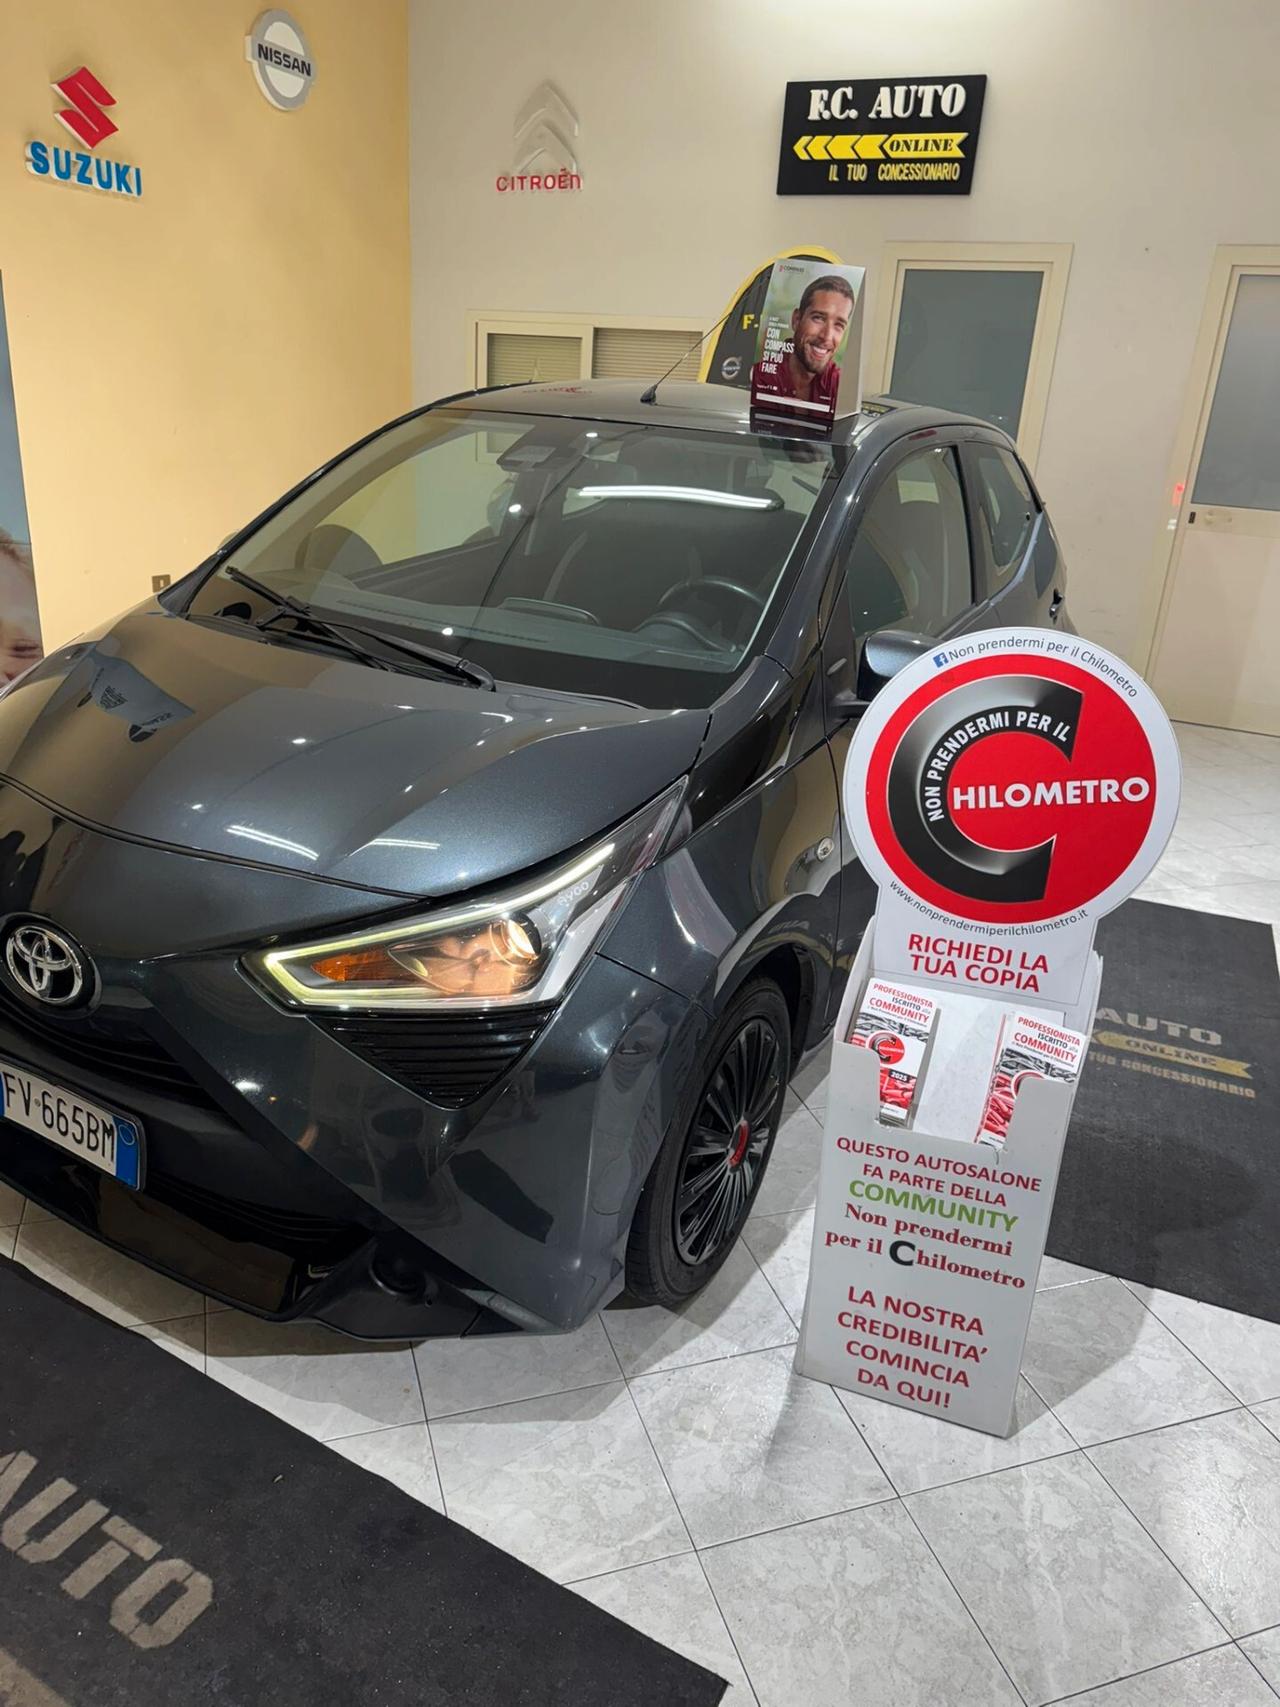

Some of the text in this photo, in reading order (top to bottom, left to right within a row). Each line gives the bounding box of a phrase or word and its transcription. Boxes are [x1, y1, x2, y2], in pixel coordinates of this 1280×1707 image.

[257, 43, 311, 77] NISSAN
[808, 83, 967, 121] F.C. AUTO
[889, 138, 954, 153] ONLINE
[29, 140, 143, 197] SUZUKI
[828, 162, 960, 182] IL TUO CONCESSIONARIO
[764, 339, 795, 354] COMPASS
[767, 327, 780, 340] CON
[761, 362, 778, 375] FARE
[763, 350, 770, 361] SI
[948, 636, 1138, 698] Non prendermi per il Chilometro
[924, 710, 1070, 822] NON PRENDERMI PER IL
[889, 880, 1089, 937] www.nonprendermiperilchilometro.it
[908, 933, 1049, 974] RICHIEDI LA
[911, 953, 1041, 993] TUA COPIA
[869, 997, 930, 1023] COMMUNITY
[873, 983, 933, 1009] PROFESSIONISTA
[892, 997, 921, 1012] ISCRITTO
[1018, 1016, 1080, 1046] PROFESSIONISTA
[1037, 1032, 1068, 1049] ISCRITTO
[1095, 1007, 1222, 1046] AUTO
[1014, 1032, 1077, 1063] COMMUNITY
[1126, 1039, 1217, 1066] ONLINE
[1121, 1059, 1256, 1099] CONCESSIONARIO
[836, 1136, 1042, 1192] QUESTO AUTOSALONE
[862, 1163, 1007, 1207] FA PARTE DELLA
[849, 1180, 1019, 1232] COMMUNITY
[844, 1203, 1013, 1257] Non prendermi
[825, 1231, 1026, 1289] per il Chilometro
[848, 1285, 984, 1336] LA NOSTRA
[846, 1340, 970, 1388] COMINCIA
[857, 1368, 951, 1408] DA QUI!
